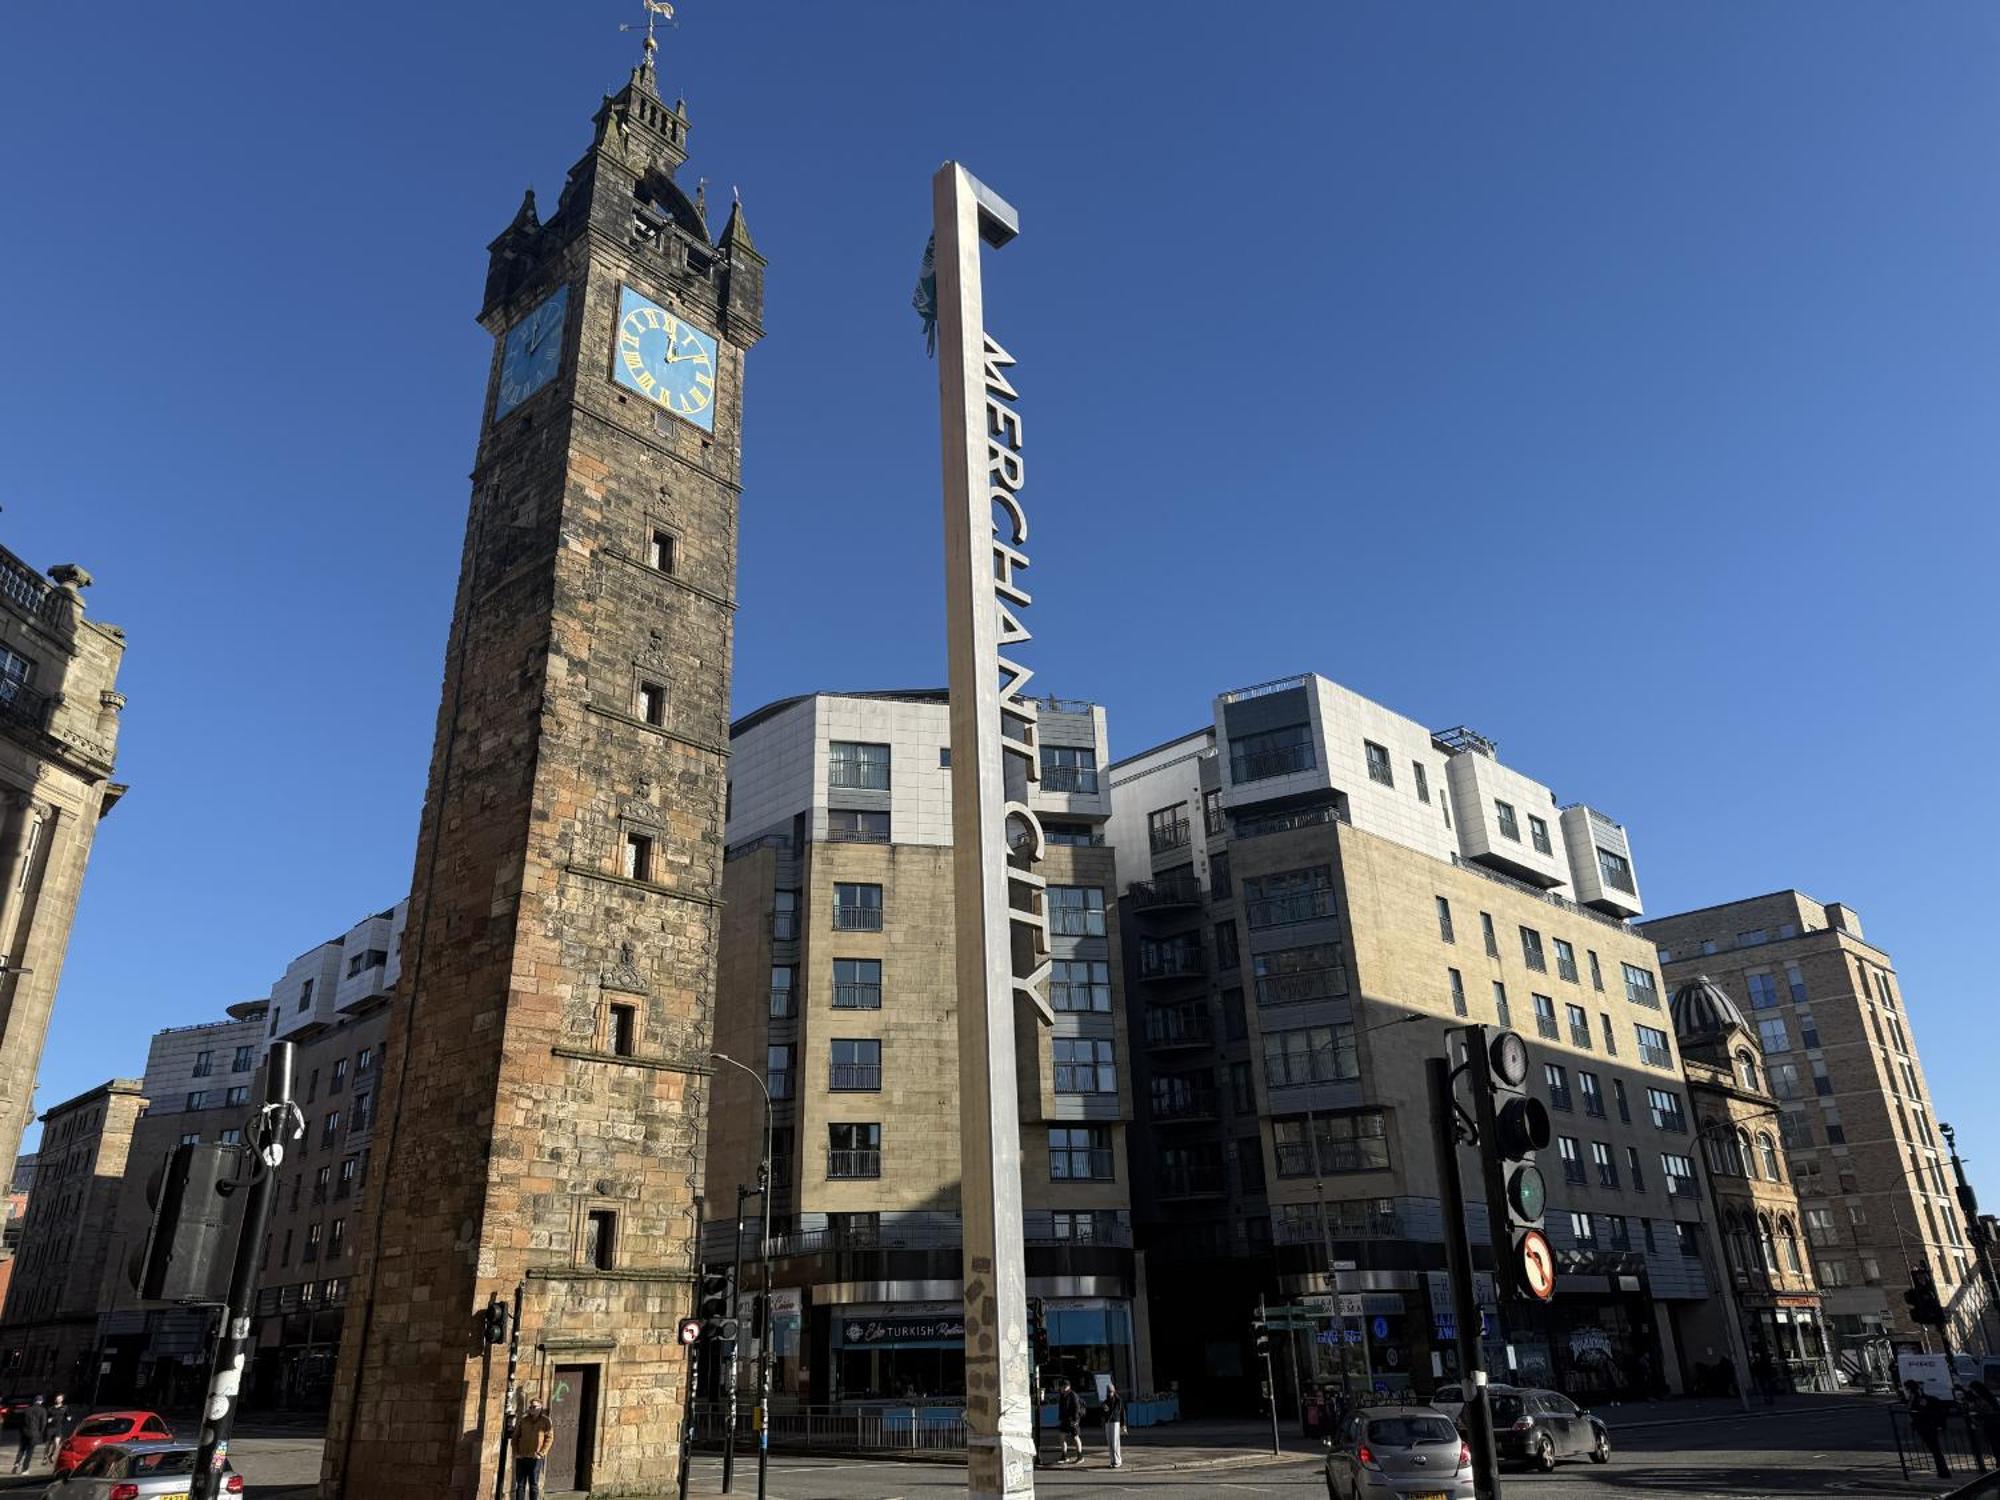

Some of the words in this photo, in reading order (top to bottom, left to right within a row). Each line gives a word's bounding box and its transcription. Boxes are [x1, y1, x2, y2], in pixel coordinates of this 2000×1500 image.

[983, 331, 1040, 782] MERCHANT
[1004, 800, 1055, 1027] CITY
[887, 1326, 934, 1337] TURKISH
